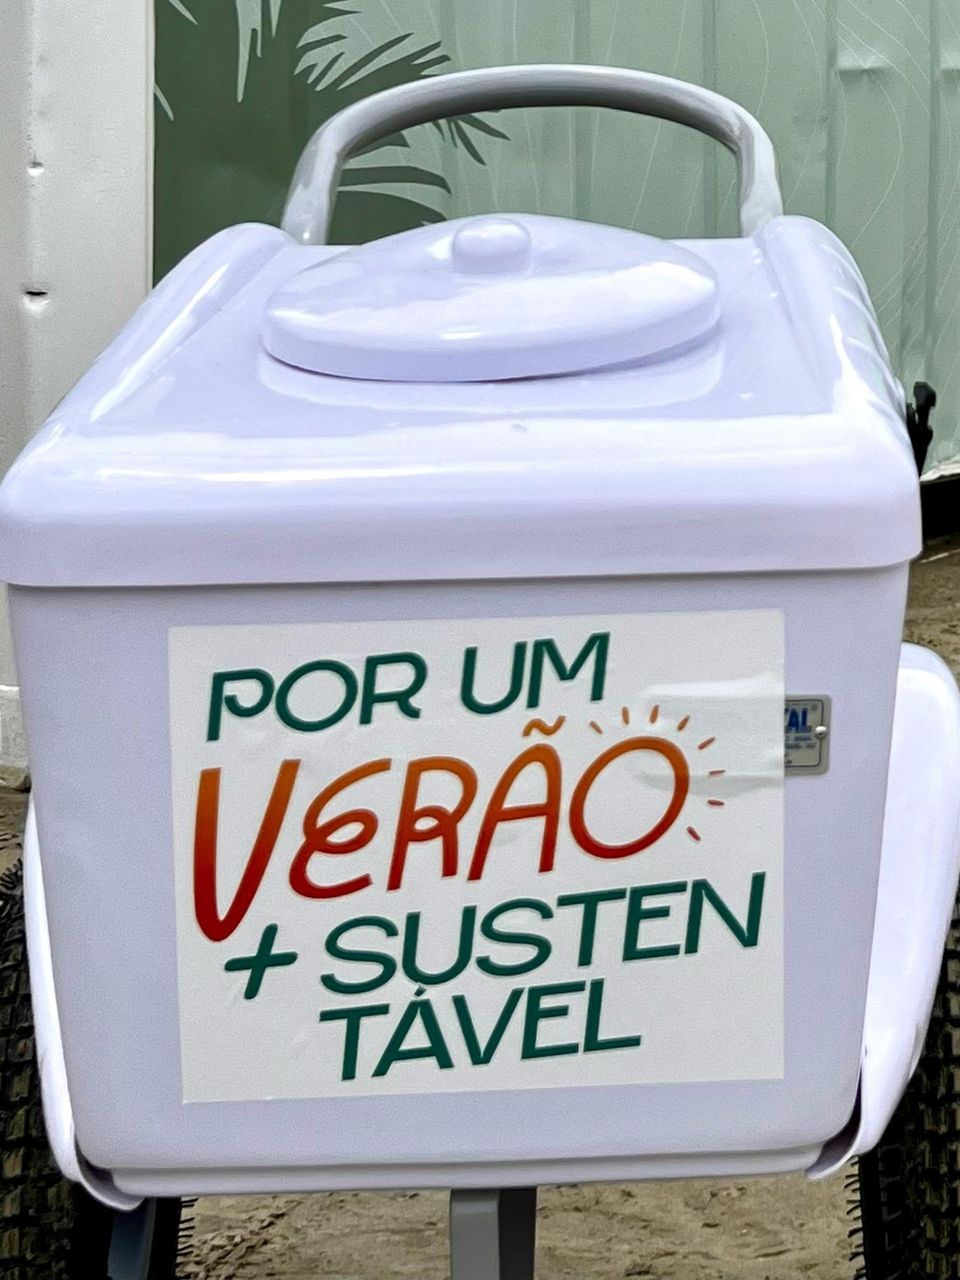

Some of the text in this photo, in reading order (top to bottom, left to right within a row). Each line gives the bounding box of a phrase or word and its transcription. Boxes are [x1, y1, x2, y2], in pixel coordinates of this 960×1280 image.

[206, 632, 610, 742] POR UM
[192, 716, 690, 942] VERÃO
[320, 872, 767, 995] SUSTEN
[319, 977, 642, 1081] TÁVEL
